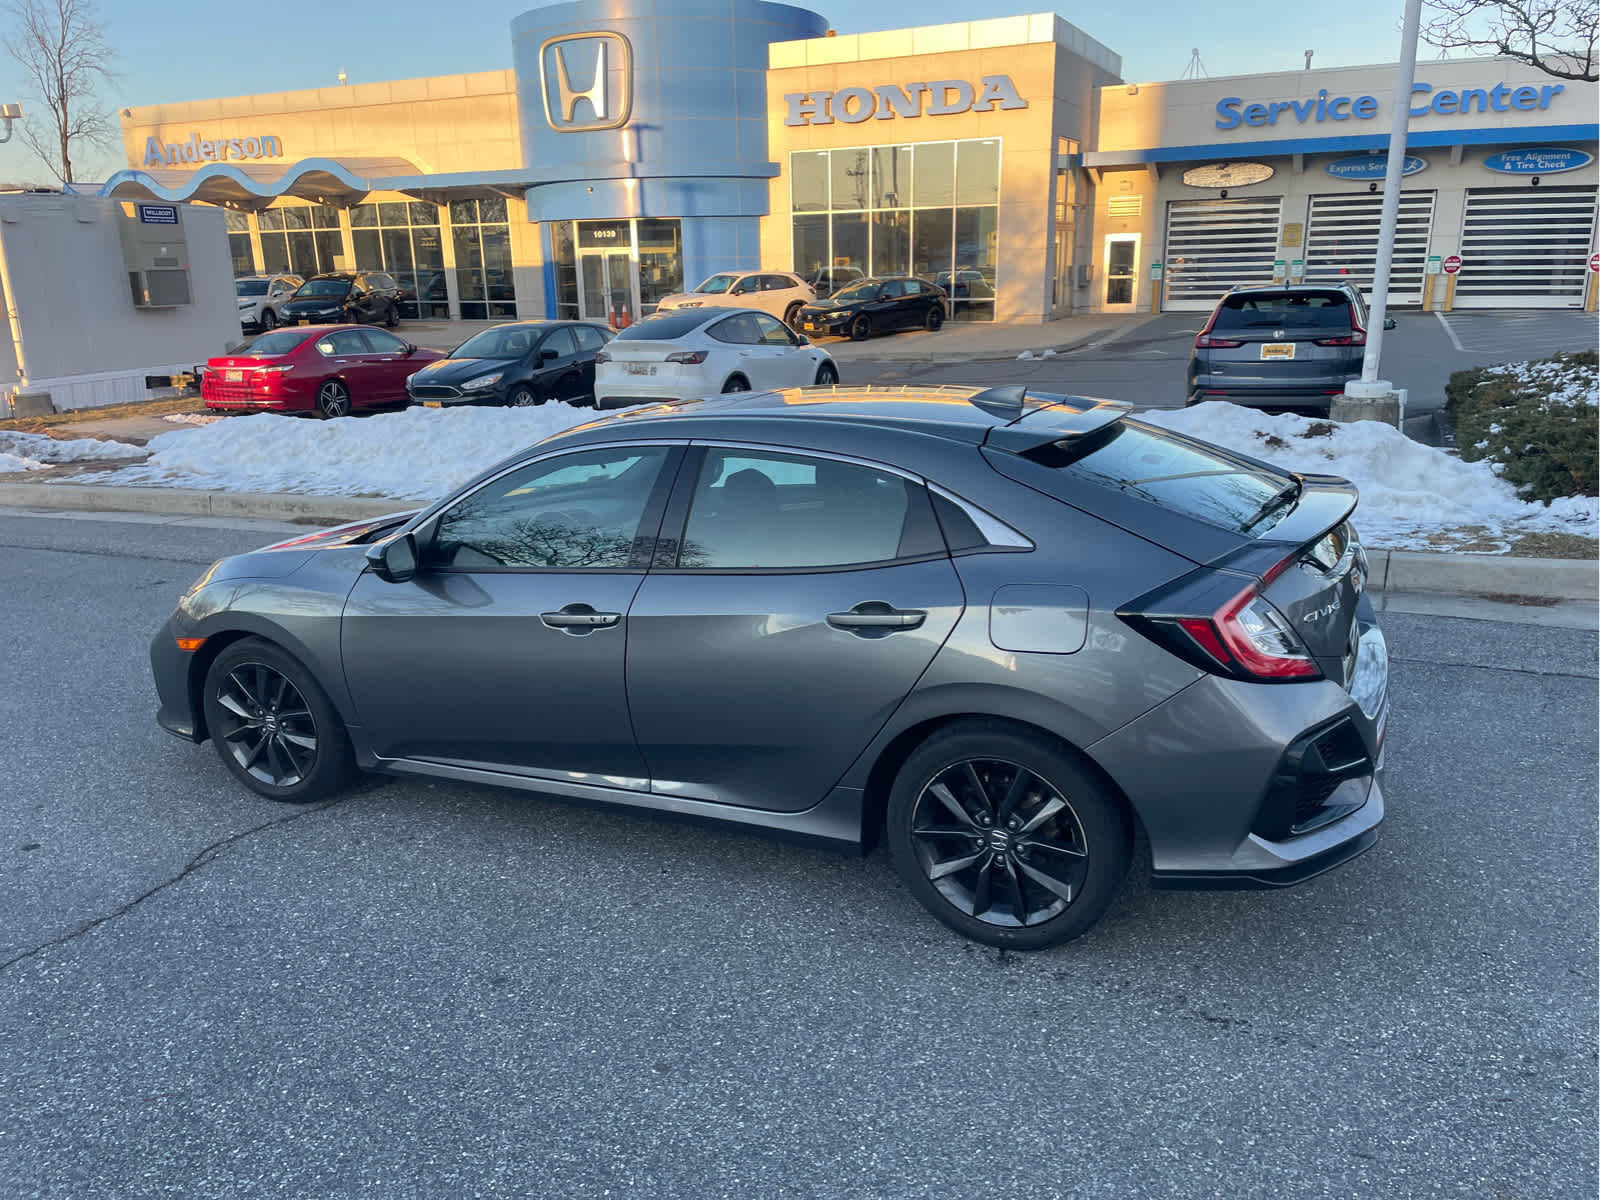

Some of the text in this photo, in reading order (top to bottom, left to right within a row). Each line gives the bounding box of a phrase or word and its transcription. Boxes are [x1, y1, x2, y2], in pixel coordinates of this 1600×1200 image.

[784, 74, 1029, 127] HONDA
[1215, 80, 1565, 130] Service Center
[143, 132, 282, 166] Anderson
[1501, 152, 1571, 162] Free Alignment
[1328, 164, 1366, 174] Express
[1517, 161, 1535, 169] Tire
[1537, 160, 1566, 169] Check
